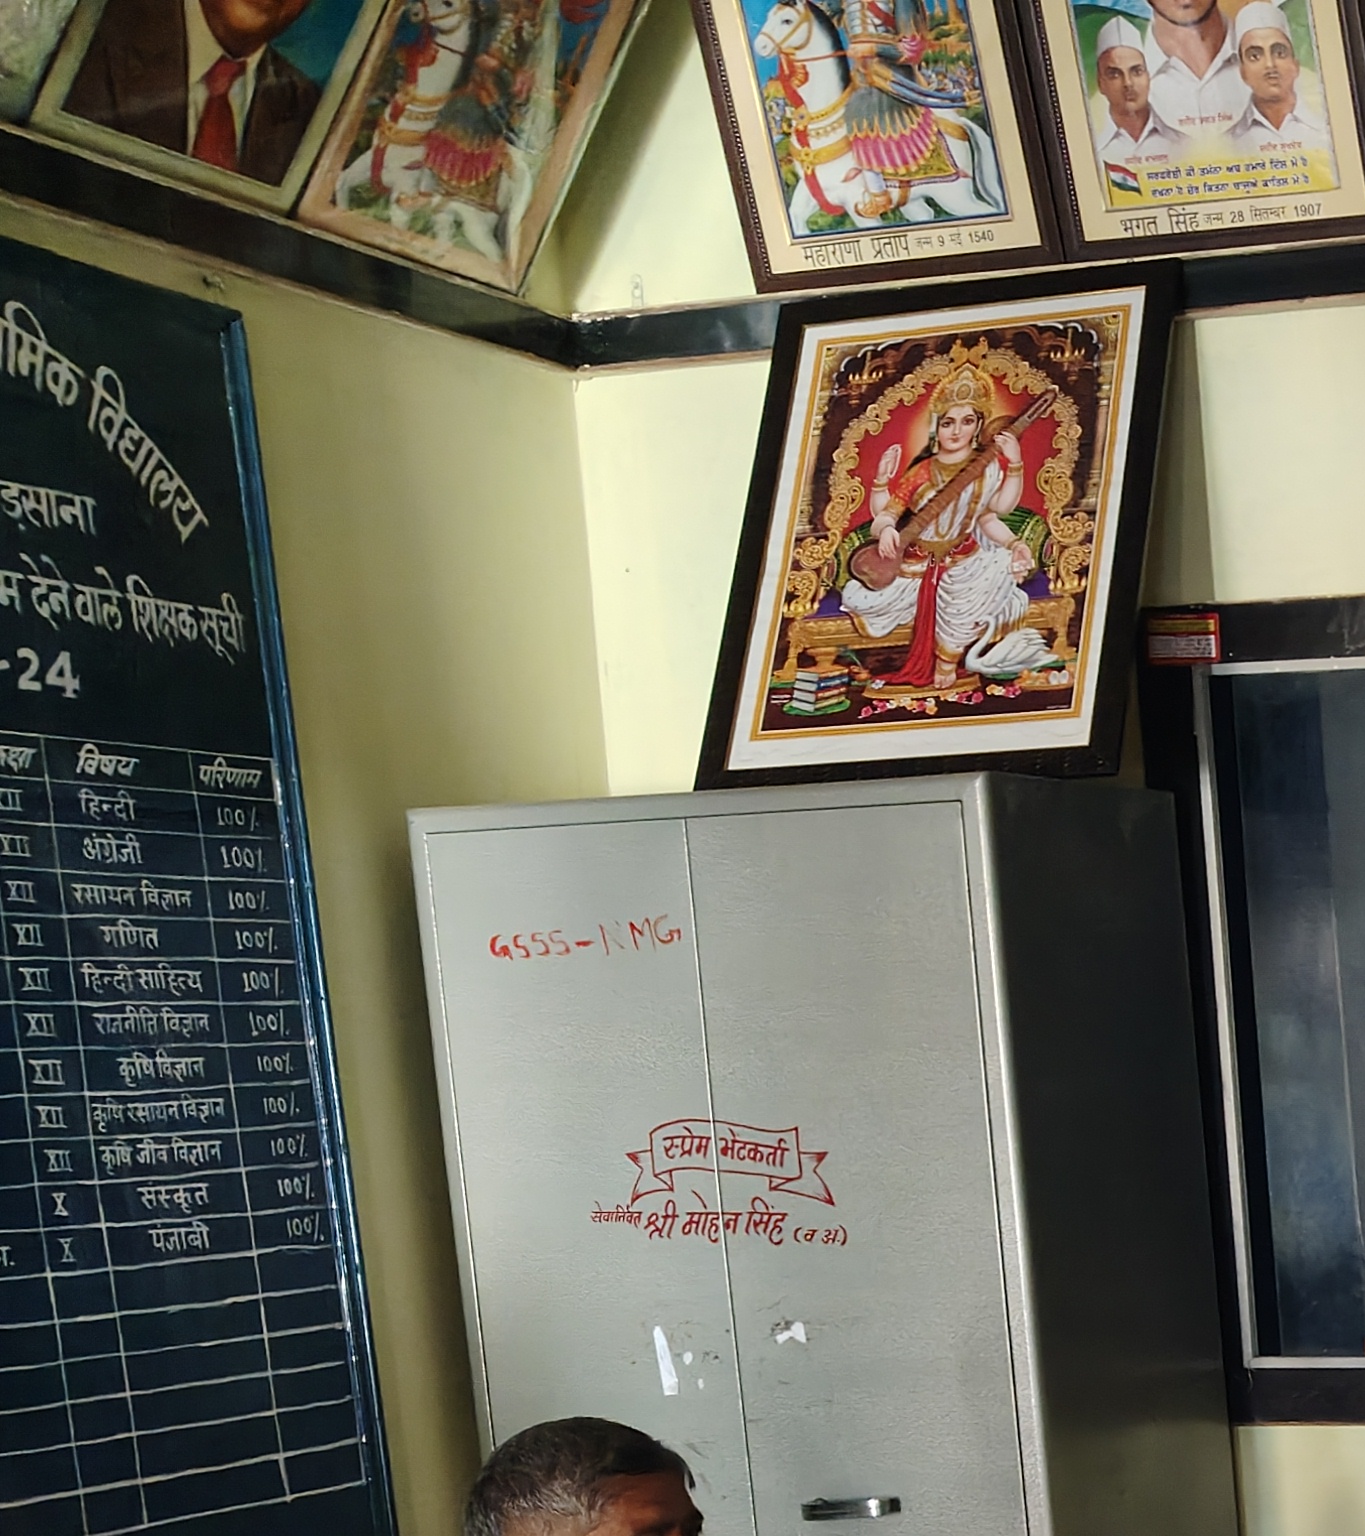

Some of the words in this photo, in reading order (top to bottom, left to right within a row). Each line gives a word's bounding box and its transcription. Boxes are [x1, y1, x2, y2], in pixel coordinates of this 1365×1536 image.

[1120, 215, 1158, 237] भगत
[1168, 206, 1199, 234] सिंह
[1203, 213, 1224, 227] जन्म
[1230, 210, 1245, 224] 28
[1294, 203, 1322, 217] 1907
[802, 239, 863, 268] महाराणा
[871, 233, 912, 264] प्रताप
[938, 236, 945, 247] 9
[968, 229, 994, 244] 1540
[88, 366, 209, 544] विद्यालय
[0, 480, 97, 537] ड़साना
[20, 552, 72, 631] देने
[73, 566, 123, 631] वाले
[125, 574, 199, 648] शिक्षक
[198, 592, 247, 666] सूची
[76, 743, 140, 776] विषय
[199, 756, 262, 788] परिणाम
[77, 787, 137, 821] हिन्दी
[5, 880, 37, 903] XII
[71, 883, 137, 907] रसायन
[139, 879, 192, 911] विज्ञान
[11, 923, 45, 946] XII
[98, 919, 159, 950] गणित
[18, 967, 52, 992] XII
[80, 962, 133, 994] हिन्दी
[135, 962, 203, 997] साहित्य
[23, 1012, 57, 1037] XII
[160, 1006, 210, 1038] विज्ञान
[28, 1059, 65, 1085] XII
[116, 1052, 155, 1087] कृषि
[156, 1049, 206, 1083] विज्ञान
[34, 1105, 68, 1128] XII
[43, 1149, 73, 1172] XII
[98, 1140, 133, 1175] कृषि
[136, 1138, 170, 1165] जीव
[170, 1137, 223, 1166] विज्ञान
[719, 1128, 790, 1169] भेंटकर्ता
[51, 1192, 69, 1216] X
[136, 1181, 210, 1214] संस्कृत
[644, 1199, 679, 1239] श्री
[682, 1189, 743, 1244] मोहन
[746, 1196, 788, 1246] सिंह
[57, 1237, 77, 1262] X
[148, 1220, 210, 1253] पंजाबी
